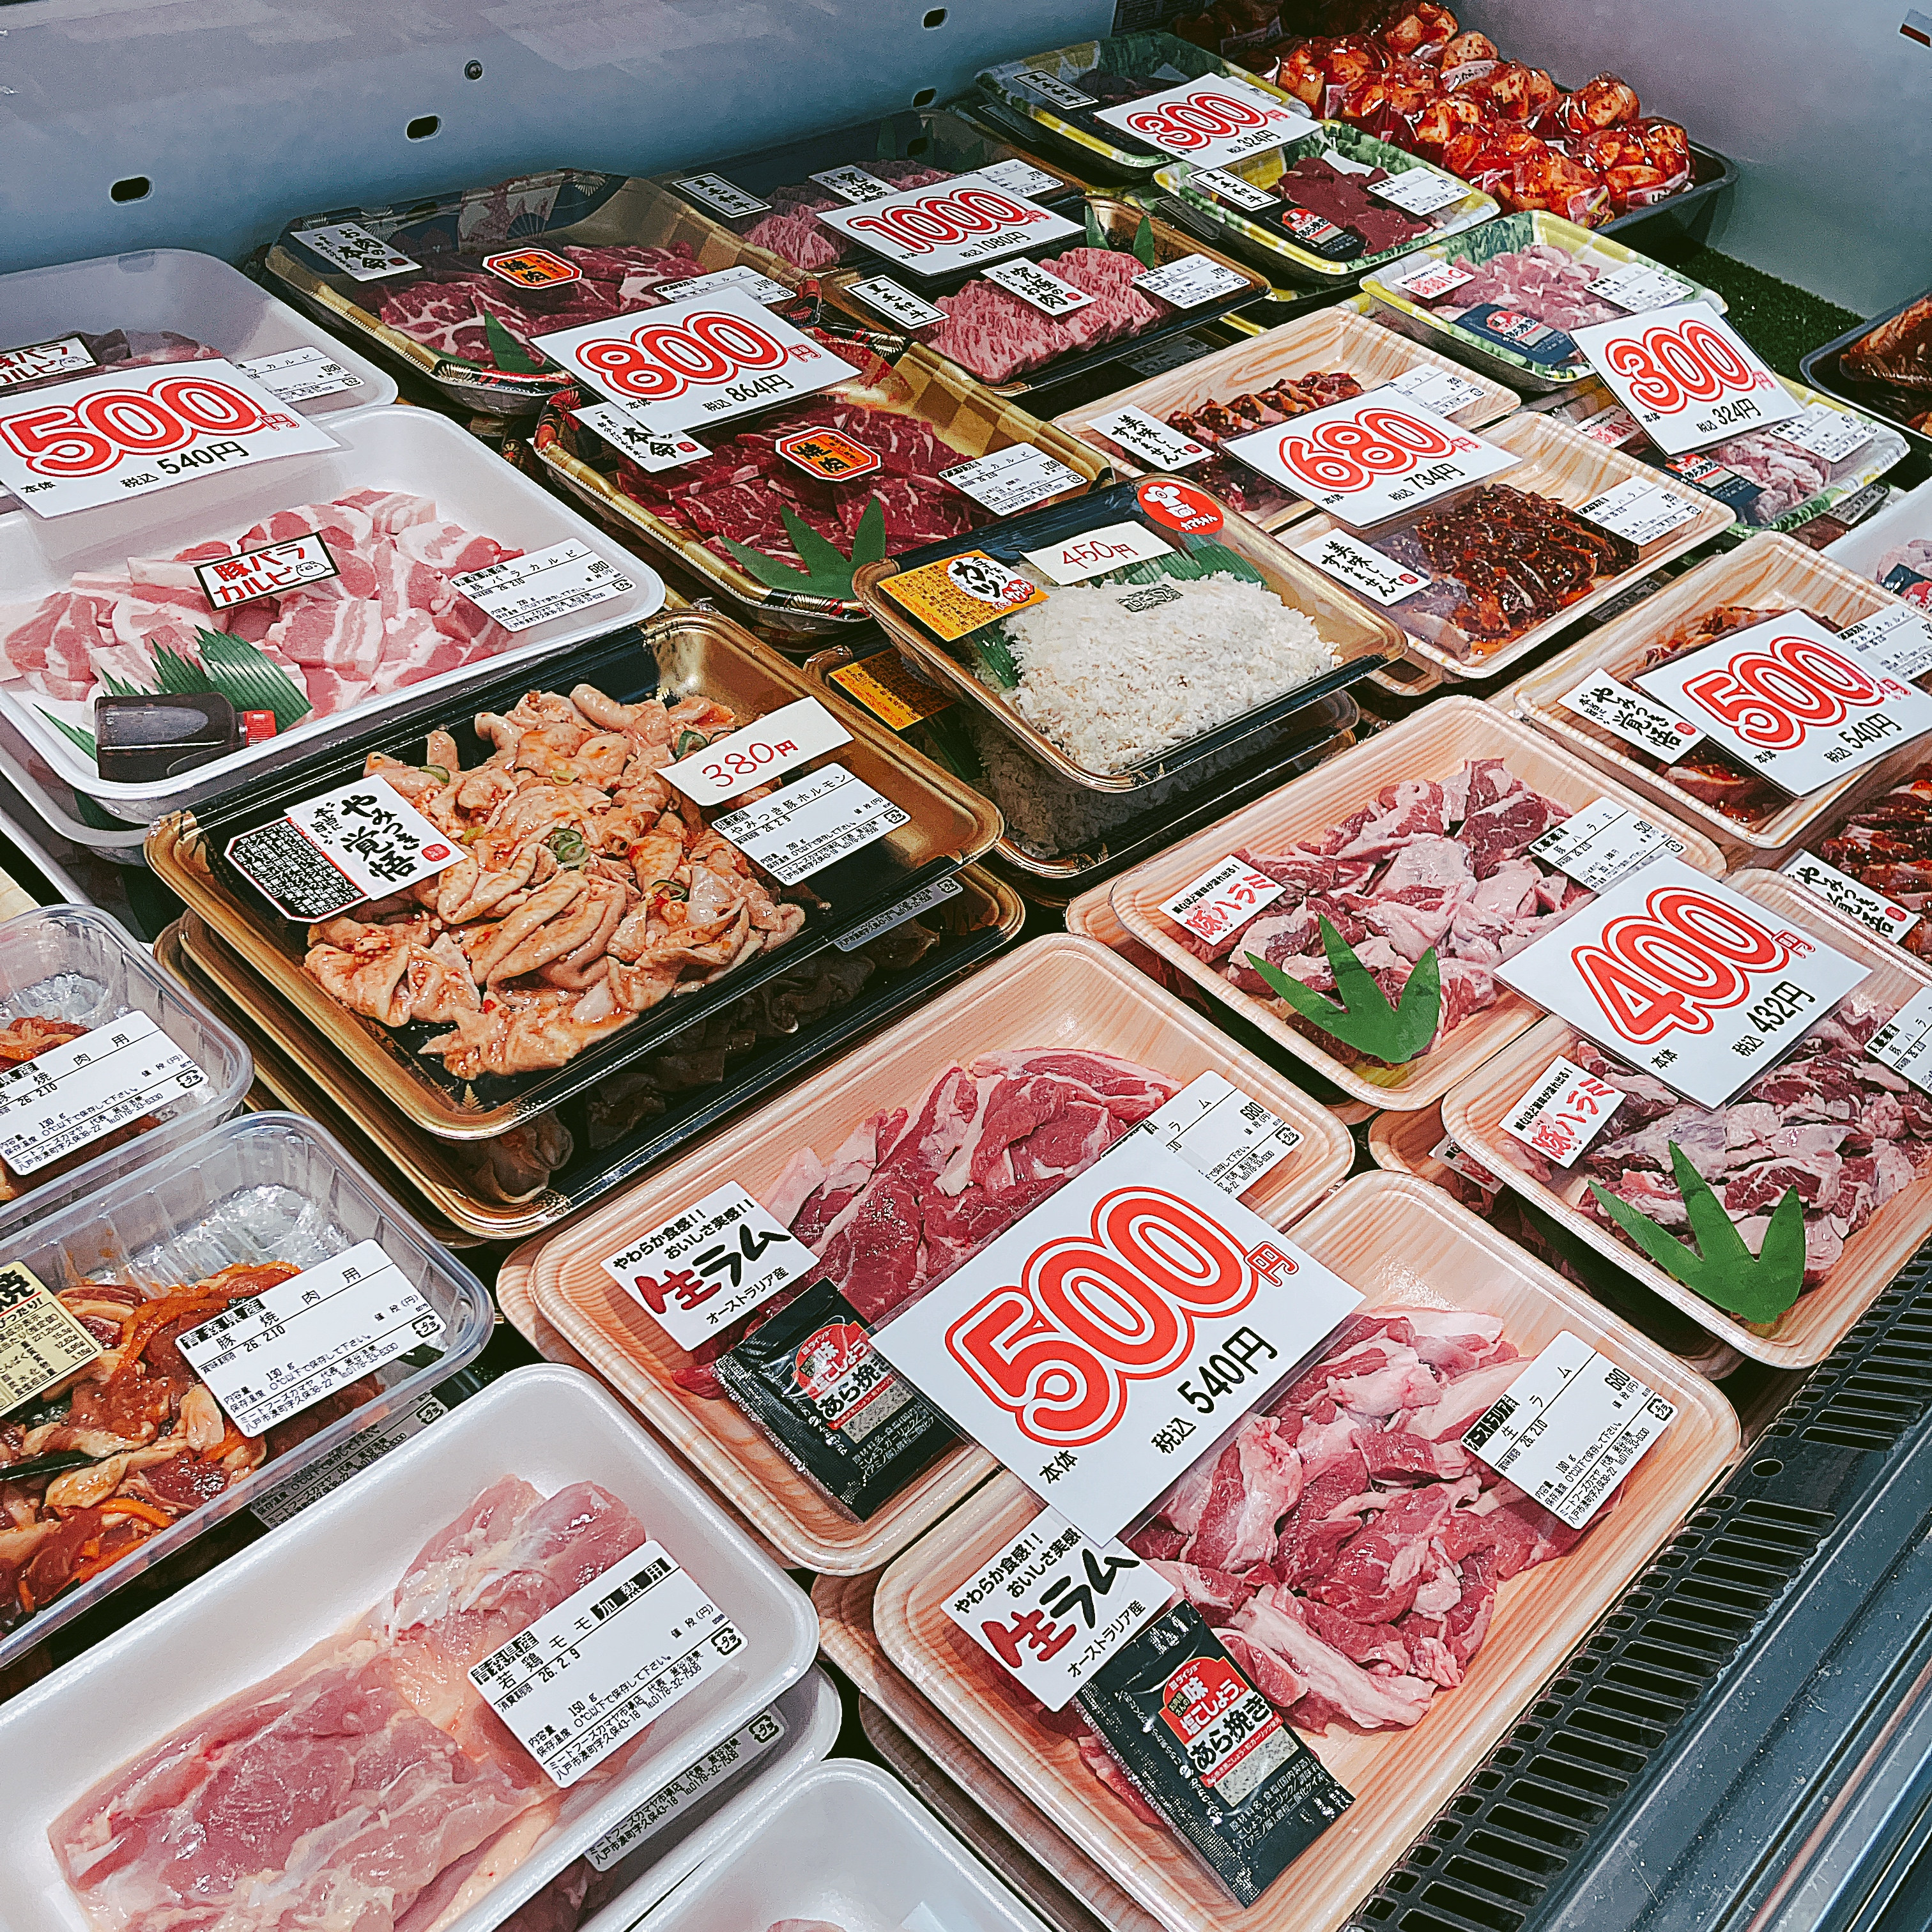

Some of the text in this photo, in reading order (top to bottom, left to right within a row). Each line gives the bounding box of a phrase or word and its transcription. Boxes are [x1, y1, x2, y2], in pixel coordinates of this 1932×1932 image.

[1237, 129, 1282, 148] 324円
[979, 231, 1032, 255] 1080円
[866, 283, 928, 319] 黒毛和牛
[0, 360, 56, 385] ルビ
[703, 373, 795, 412] 税込 864円
[1712, 398, 1761, 425] 324円
[120, 441, 250, 488] 税込 540円
[1388, 463, 1466, 502] 税込 734円
[21, 481, 56, 493] 本体
[212, 543, 305, 582] 豚バラ
[587, 560, 610, 574] 680
[1063, 540, 1139, 569] 450円
[213, 565, 302, 602] カルビ
[1321, 554, 1396, 597] すみません
[1589, 687, 1671, 727] やみつき
[1613, 709, 1683, 749] 覚悟
[1823, 713, 1903, 765] 税込 540円
[702, 739, 799, 789] 380円
[1754, 750, 1777, 765] 本体
[341, 794, 420, 850] やみつき
[340, 825, 418, 882] 覚悟
[1731, 980, 1816, 1057] 税込 432円
[1888, 1006, 1932, 1055] 豚ハラ
[1650, 1048, 1679, 1070] 本体
[1239, 1101, 1265, 1121] 680
[1531, 1077, 1616, 1160] 豚ハラミ
[633, 1223, 793, 1315] 生ラム
[705, 1266, 790, 1326] オーストラリア産
[264, 1367, 282, 1381] 130
[1151, 1326, 1278, 1455] 税込 540円
[1604, 1367, 1630, 1392] 680
[1039, 1450, 1080, 1485] 本体
[1555, 1460, 1570, 1474] 180
[980, 1547, 1140, 1669] 生ラム
[1067, 1599, 1147, 1678] オーストラリア産
[1181, 1676, 1209, 1701] 味
[528, 1724, 557, 1747] 内容量
[568, 1701, 585, 1718] 150
[1186, 1692, 1273, 1774] あら挽き
[1229, 1800, 1263, 1832] 原材料名
